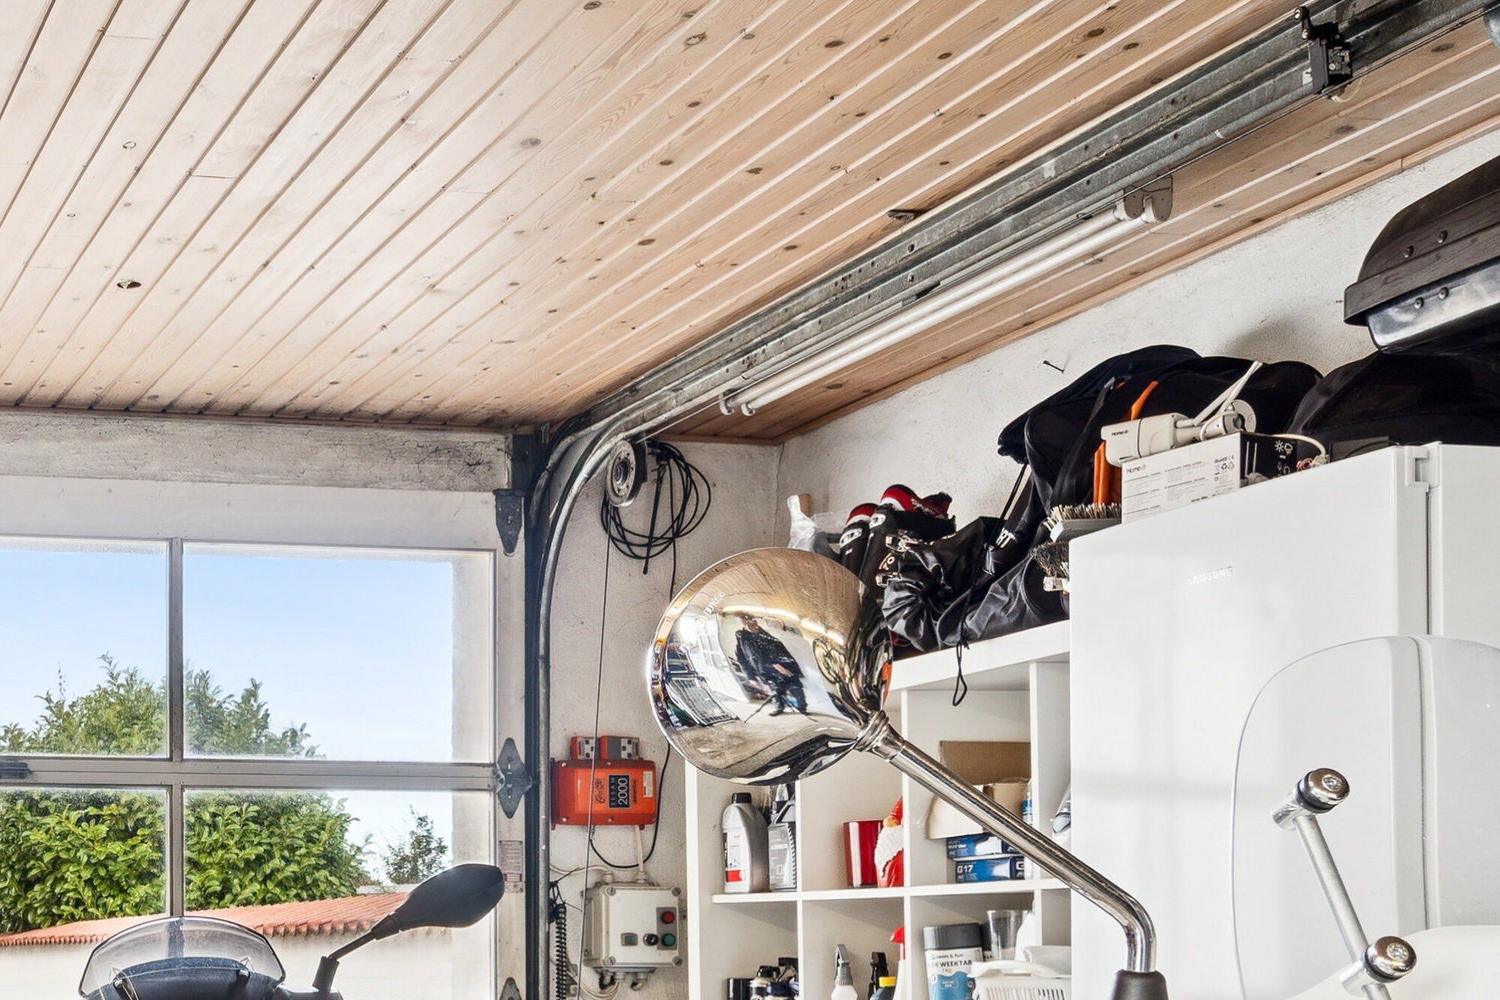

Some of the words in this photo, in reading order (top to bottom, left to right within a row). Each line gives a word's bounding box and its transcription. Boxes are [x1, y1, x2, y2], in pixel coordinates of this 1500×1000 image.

[617, 777, 628, 805] 2000
[956, 864, 974, 874] G17
[940, 960, 973, 968] WEEKTAB
